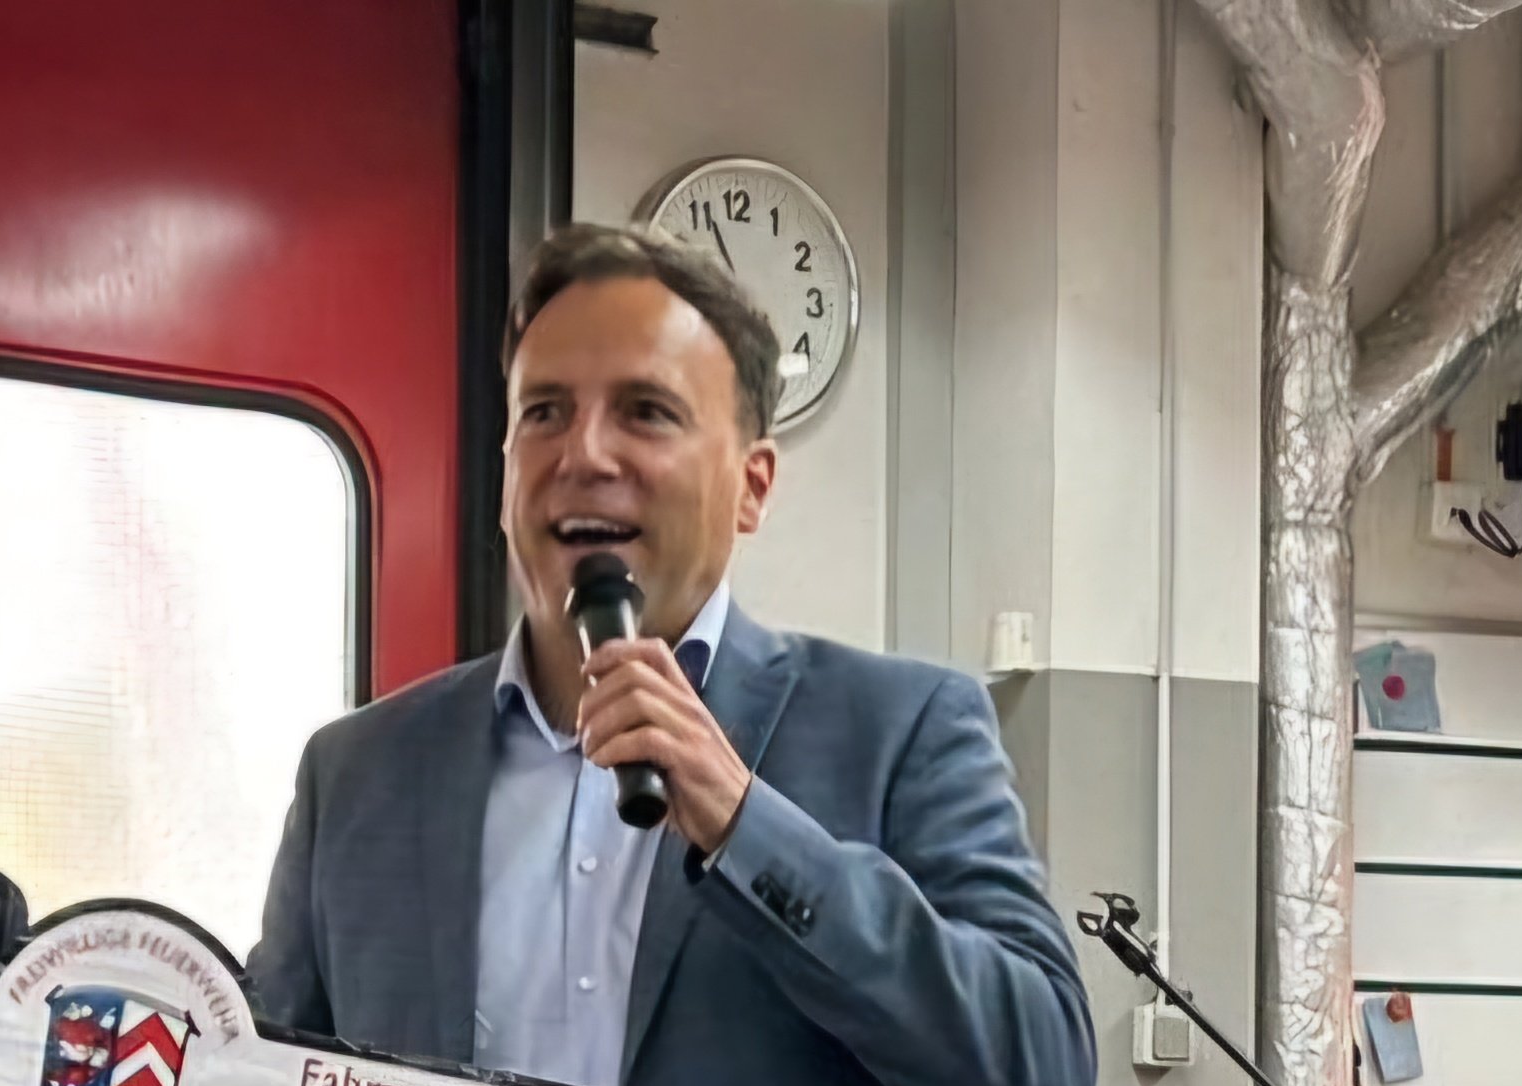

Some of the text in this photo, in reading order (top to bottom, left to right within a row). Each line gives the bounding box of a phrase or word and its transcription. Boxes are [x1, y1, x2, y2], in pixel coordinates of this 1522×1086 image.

[688, 199, 712, 232] 11
[722, 188, 751, 223] 12
[769, 205, 780, 237] 1
[793, 240, 812, 272] 2
[805, 286, 825, 319] 3
